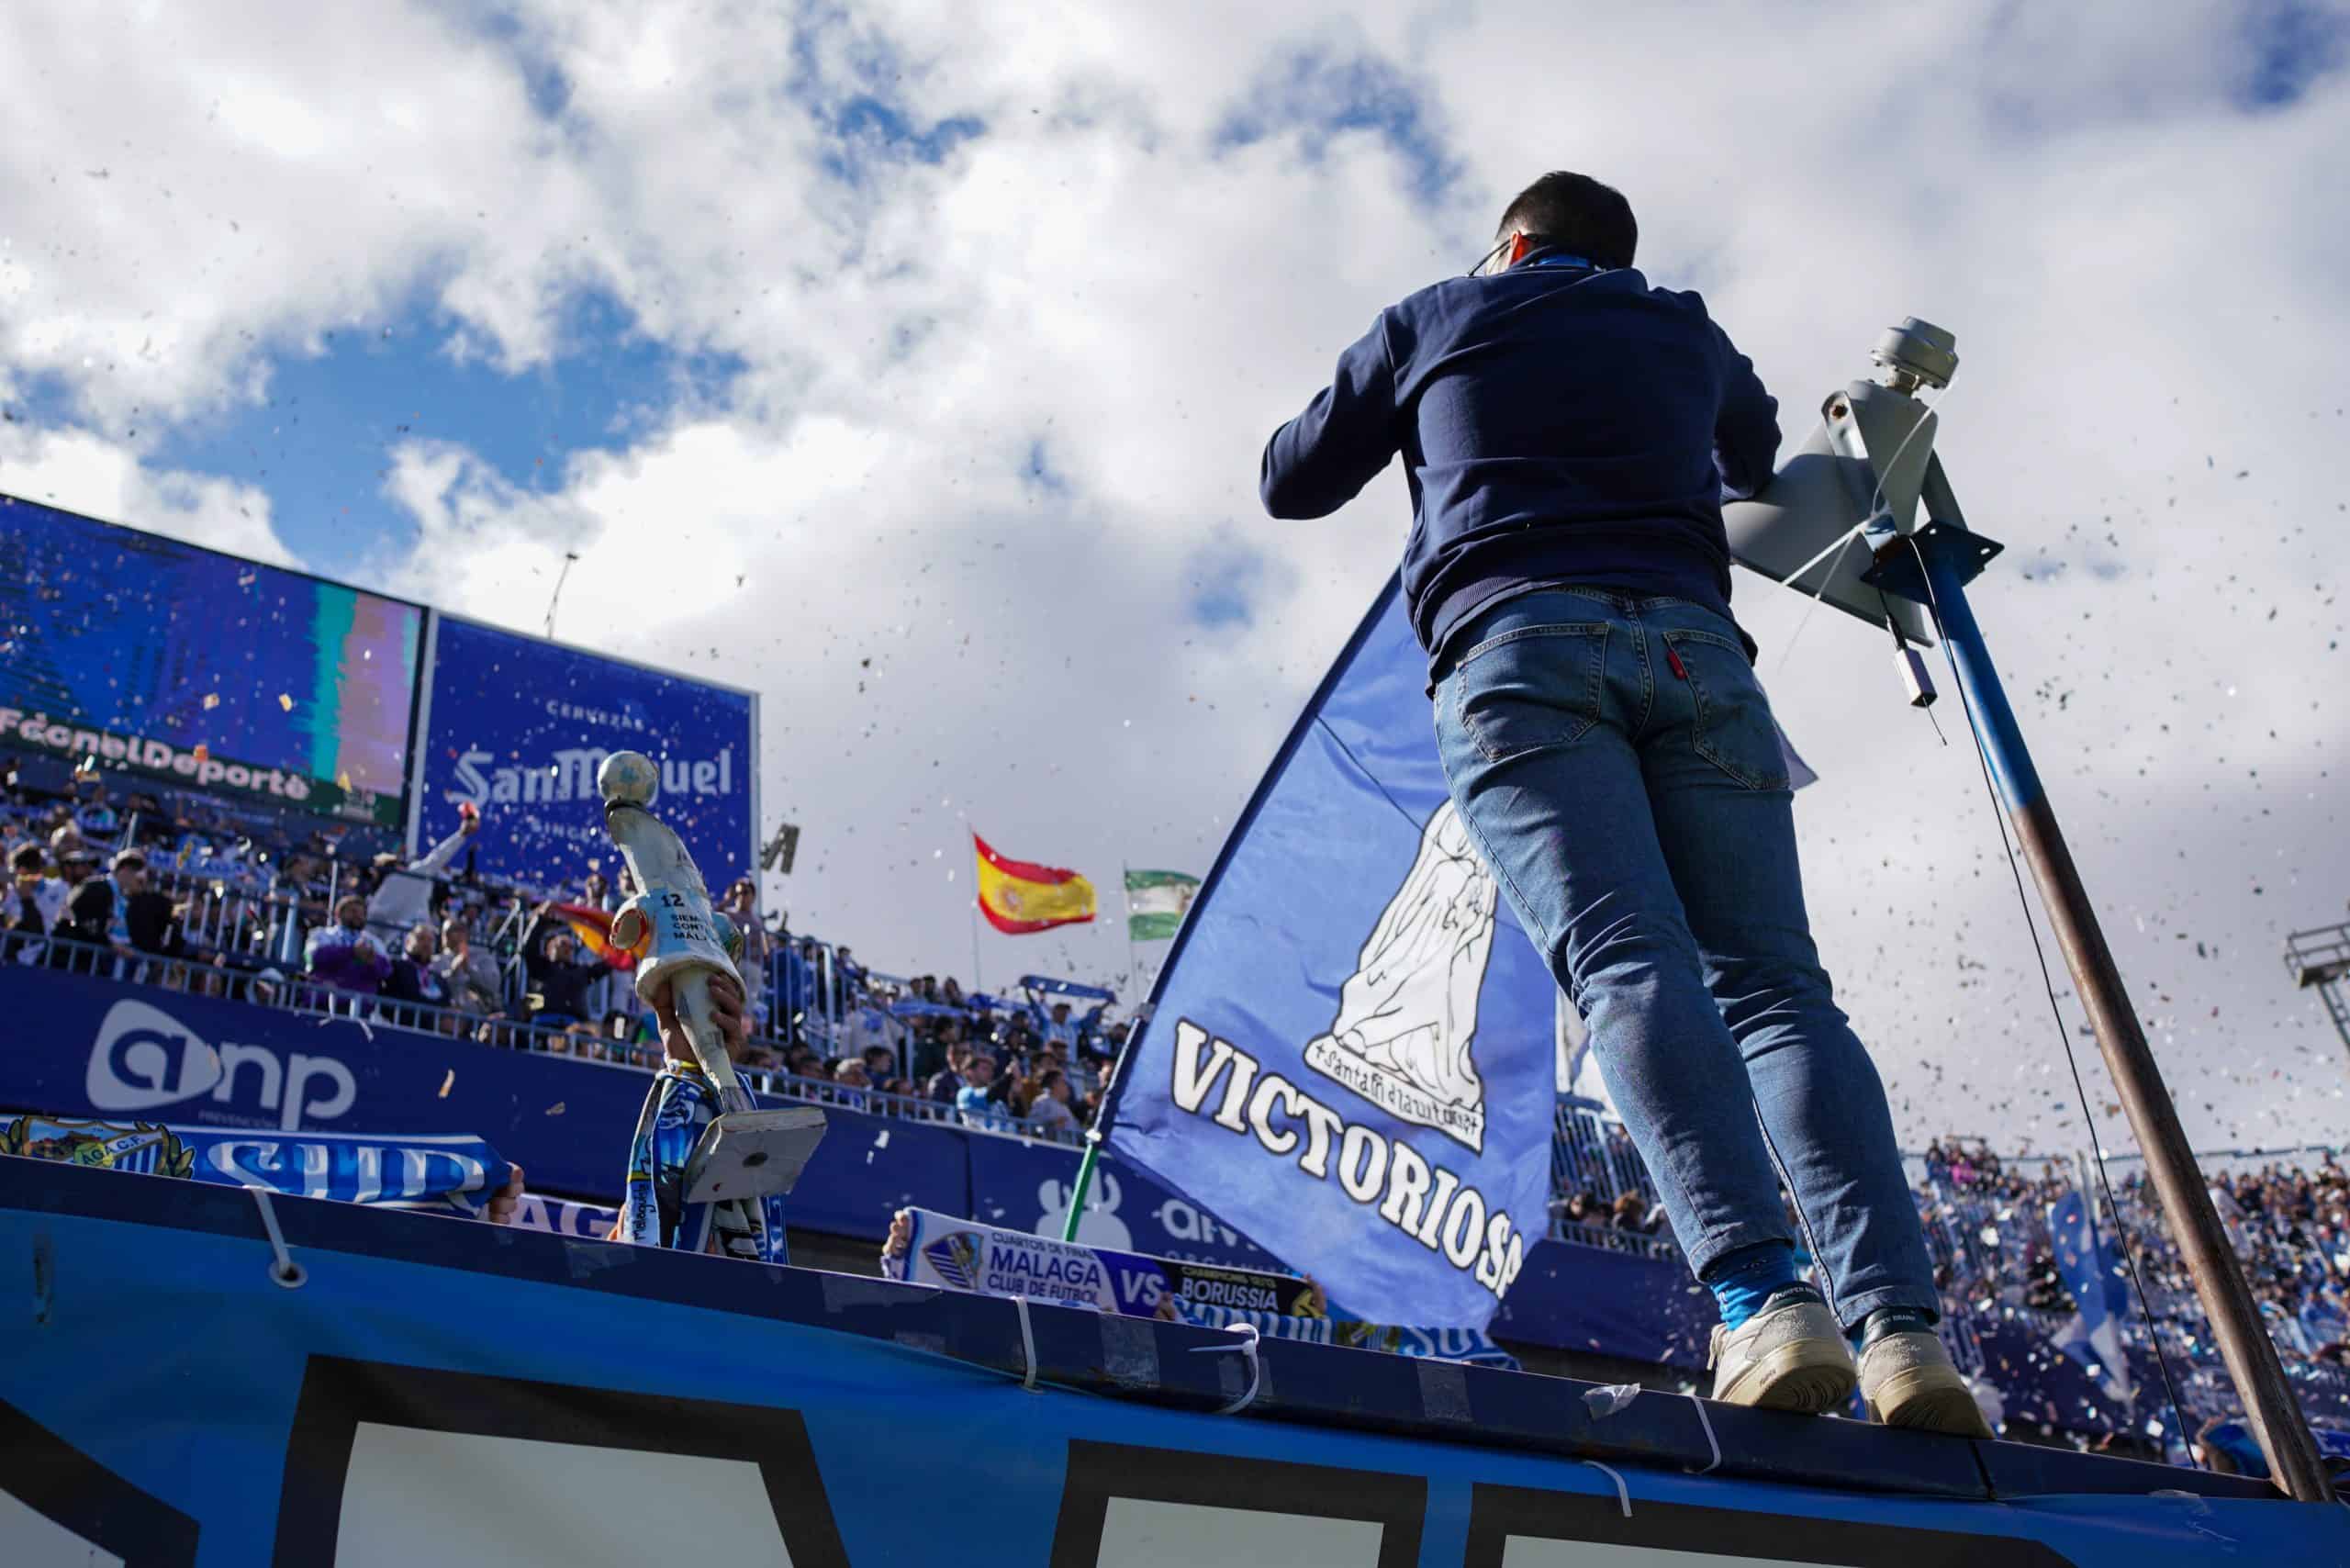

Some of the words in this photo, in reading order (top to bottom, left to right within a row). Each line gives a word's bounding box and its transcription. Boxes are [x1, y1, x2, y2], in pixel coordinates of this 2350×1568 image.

[661, 893, 684, 907] 12
[991, 1232, 1045, 1252] CUARTOS
[989, 1246, 1102, 1289] MALAGA
[988, 1273, 1024, 1294] CLUB
[1029, 1280, 1047, 1297] DE
[1121, 1269, 1166, 1307] VS
[1181, 1277, 1279, 1311] BORUSSIA
